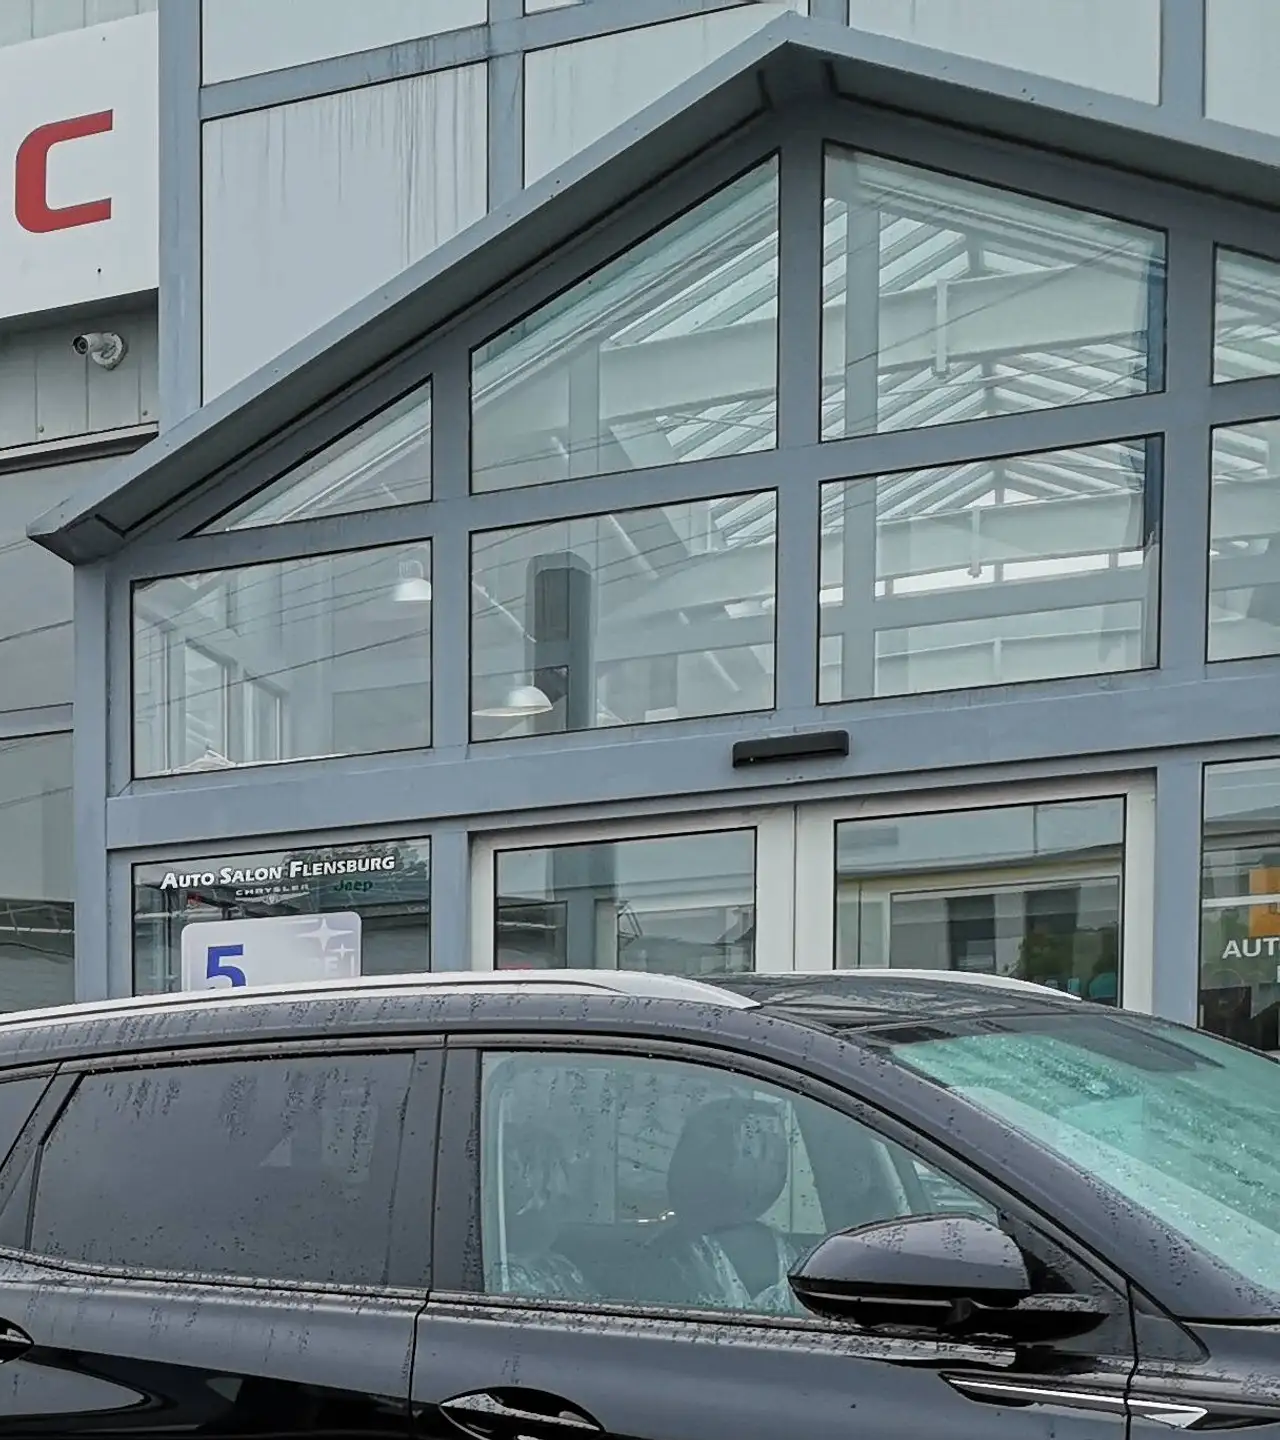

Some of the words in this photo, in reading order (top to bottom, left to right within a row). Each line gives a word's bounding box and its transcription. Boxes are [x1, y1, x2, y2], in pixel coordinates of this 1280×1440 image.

[160, 872, 214, 889] AUTO
[220, 866, 282, 885] SALON
[290, 856, 395, 877] FLENSBURG
[1222, 937, 1280, 958] AUT
